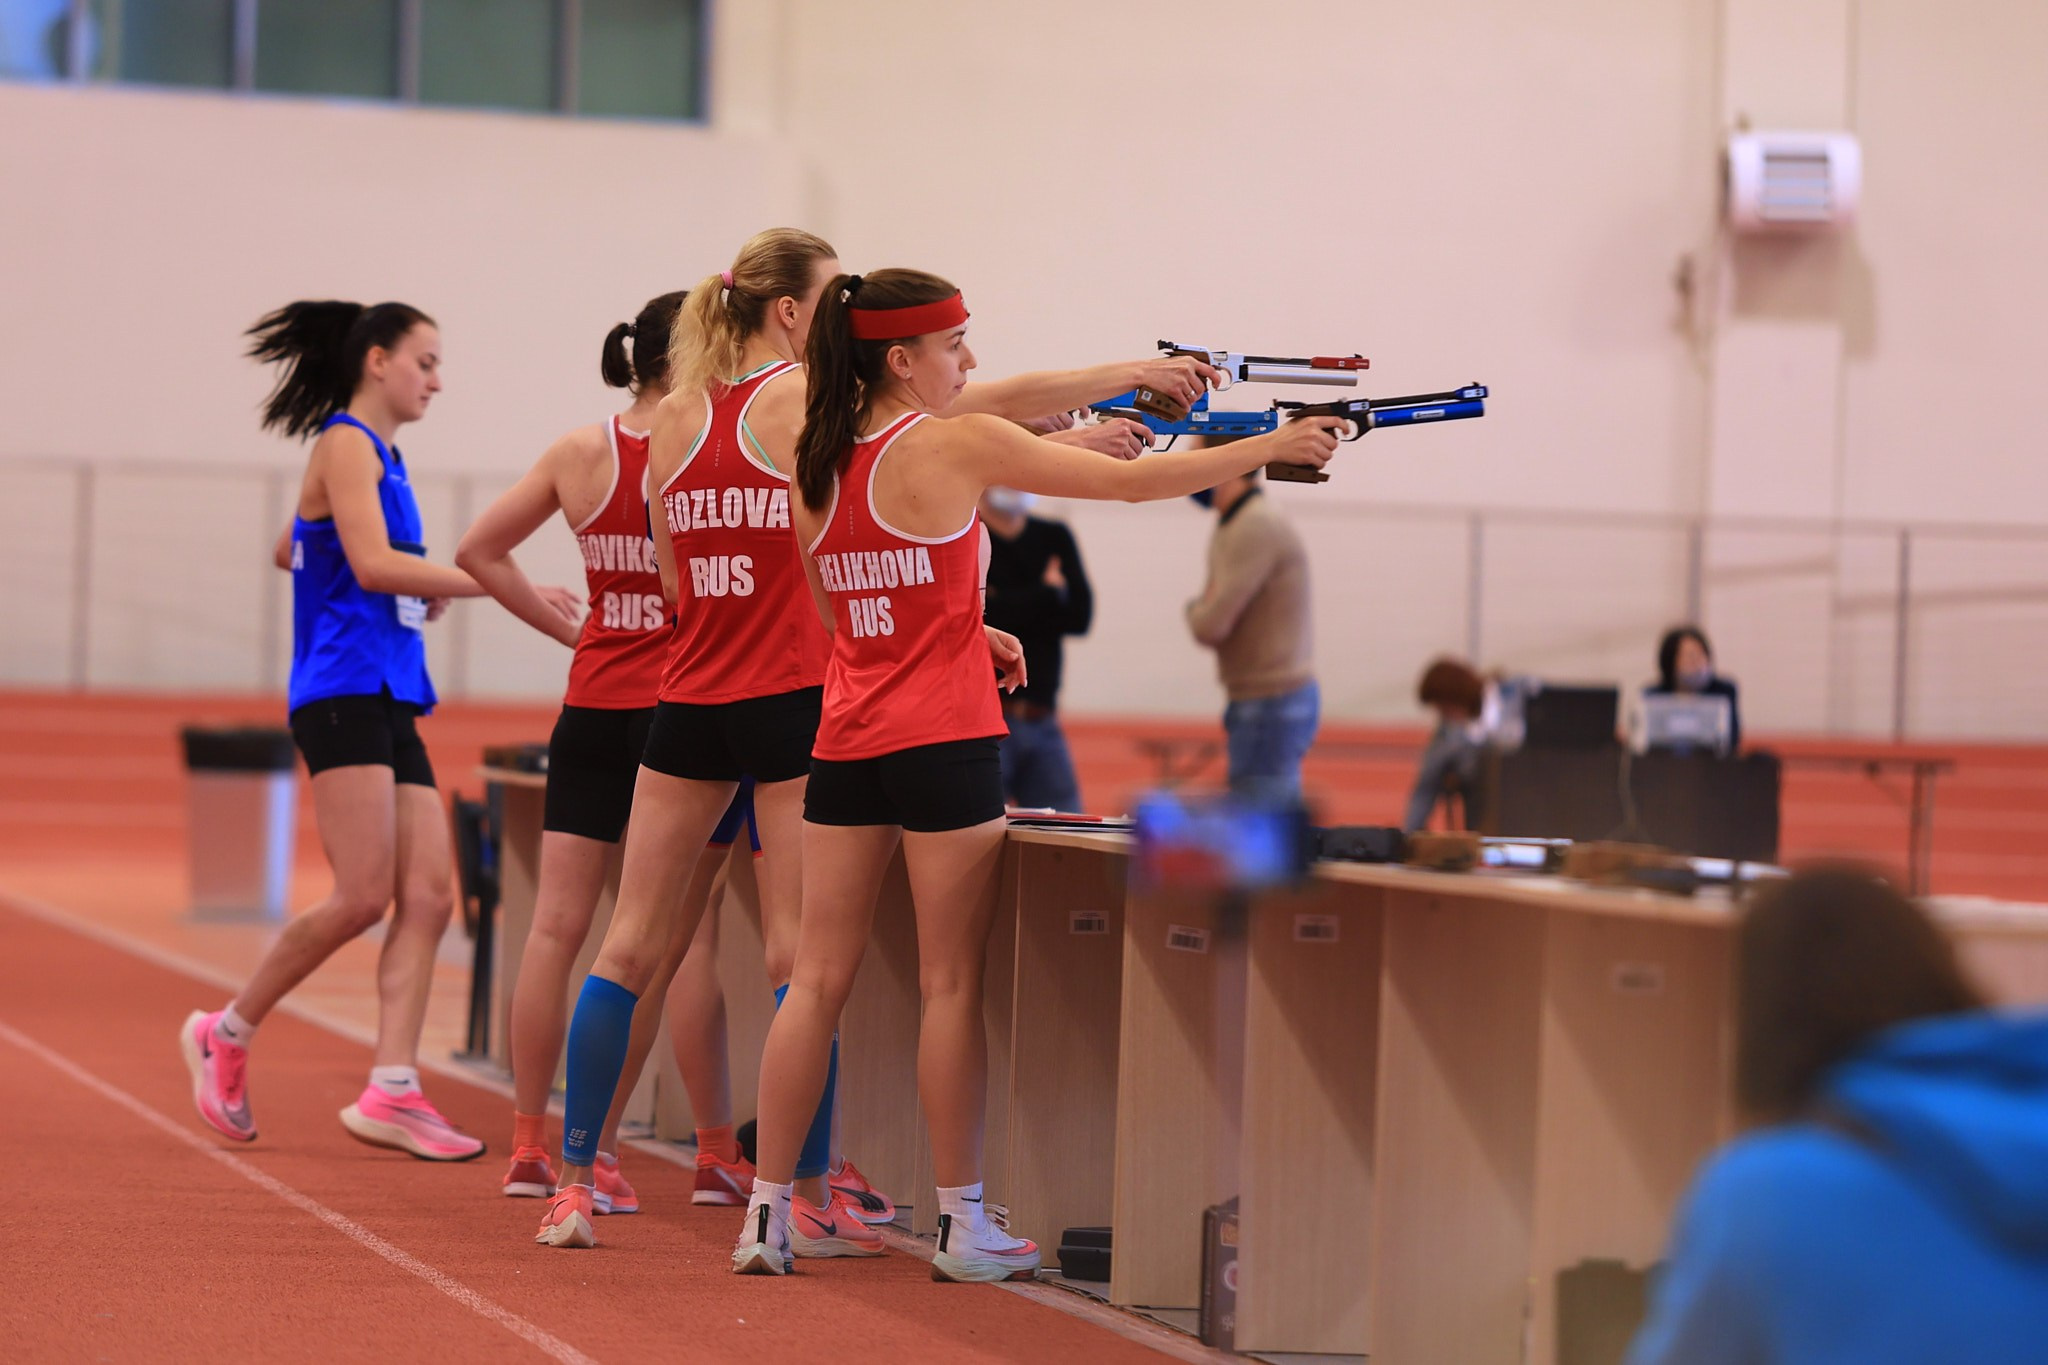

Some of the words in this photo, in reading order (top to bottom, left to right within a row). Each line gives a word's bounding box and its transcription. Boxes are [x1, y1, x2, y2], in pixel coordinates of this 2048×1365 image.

[689, 555, 755, 597] RUS
[603, 591, 664, 630] RUS
[848, 596, 895, 638] RUS
